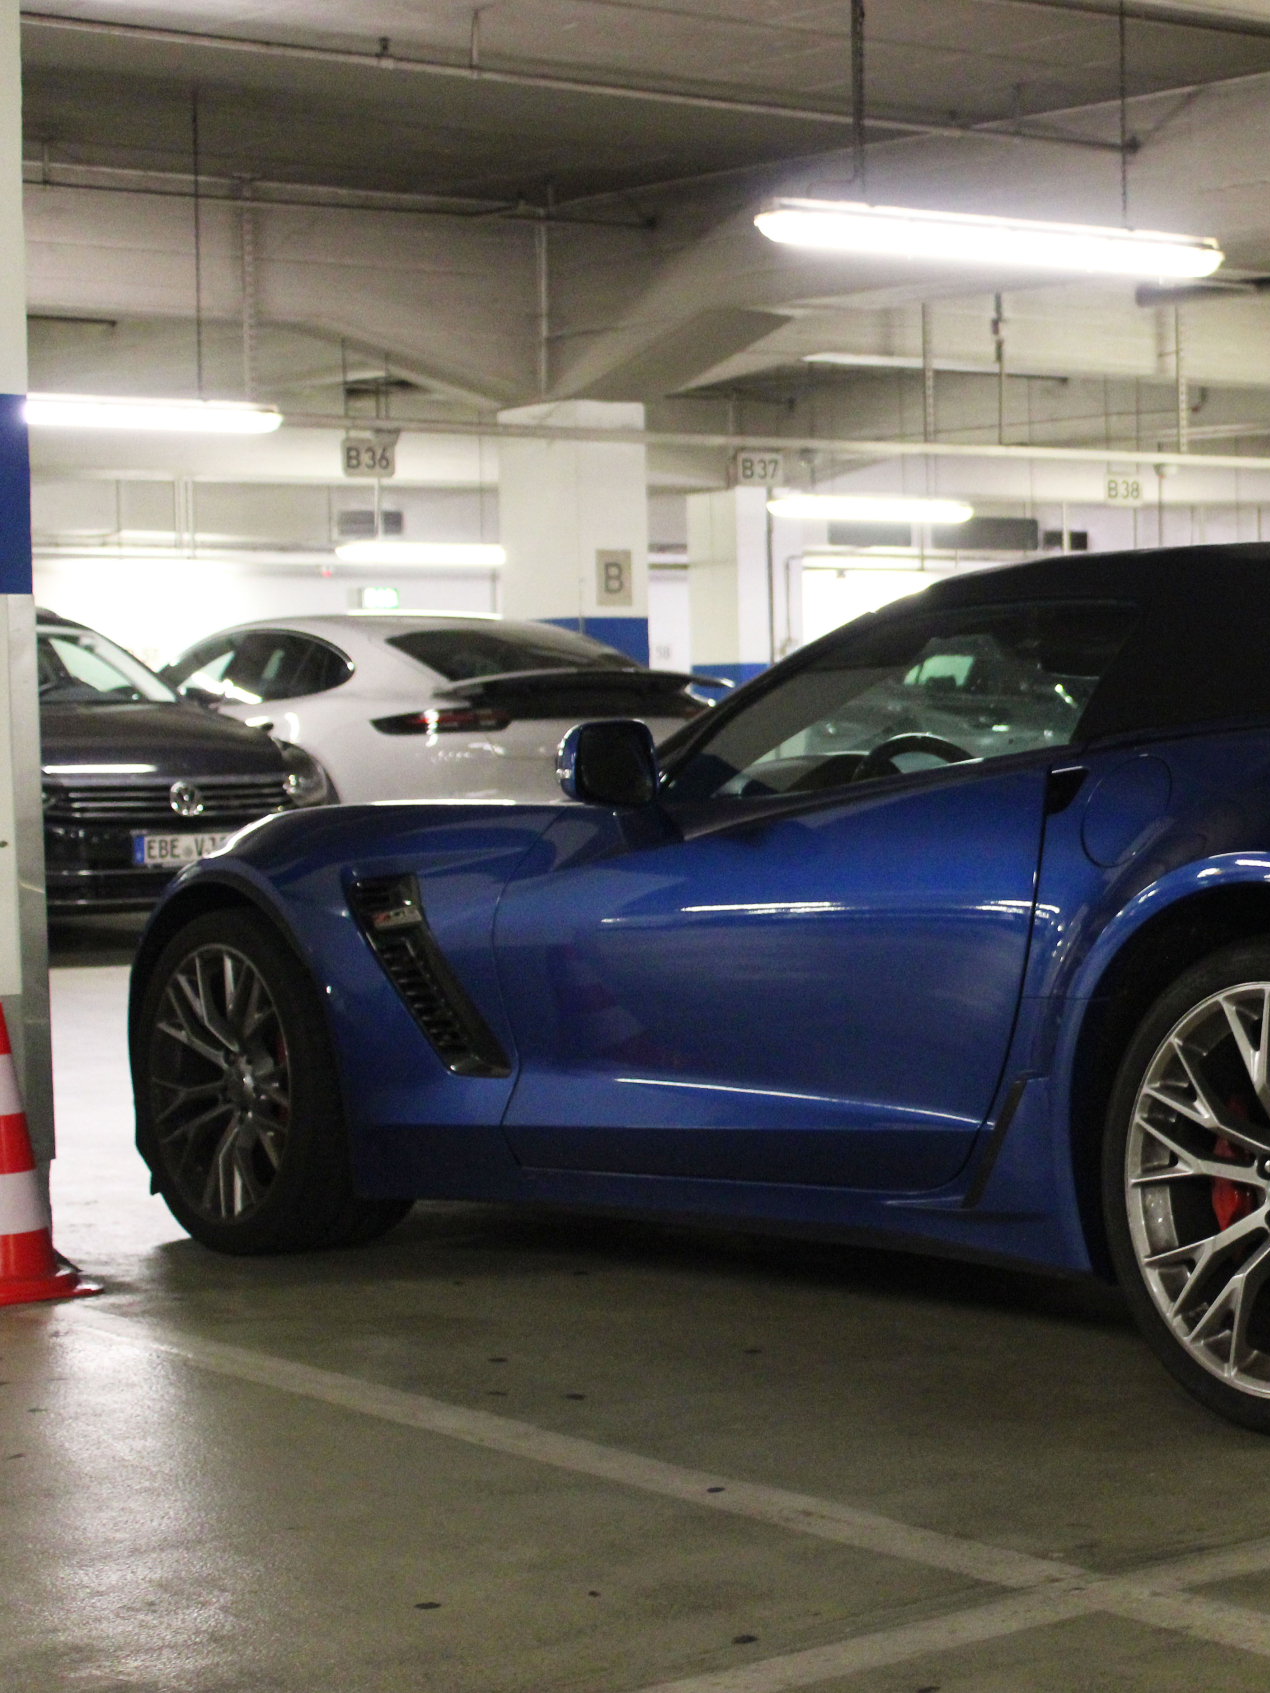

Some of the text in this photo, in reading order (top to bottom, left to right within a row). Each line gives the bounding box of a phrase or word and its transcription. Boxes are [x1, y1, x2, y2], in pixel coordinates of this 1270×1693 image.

[346, 446, 390, 470] B36
[742, 458, 778, 479] B37
[1107, 479, 1140, 499] B38
[604, 562, 624, 594] B
[147, 838, 180, 859] EBE
